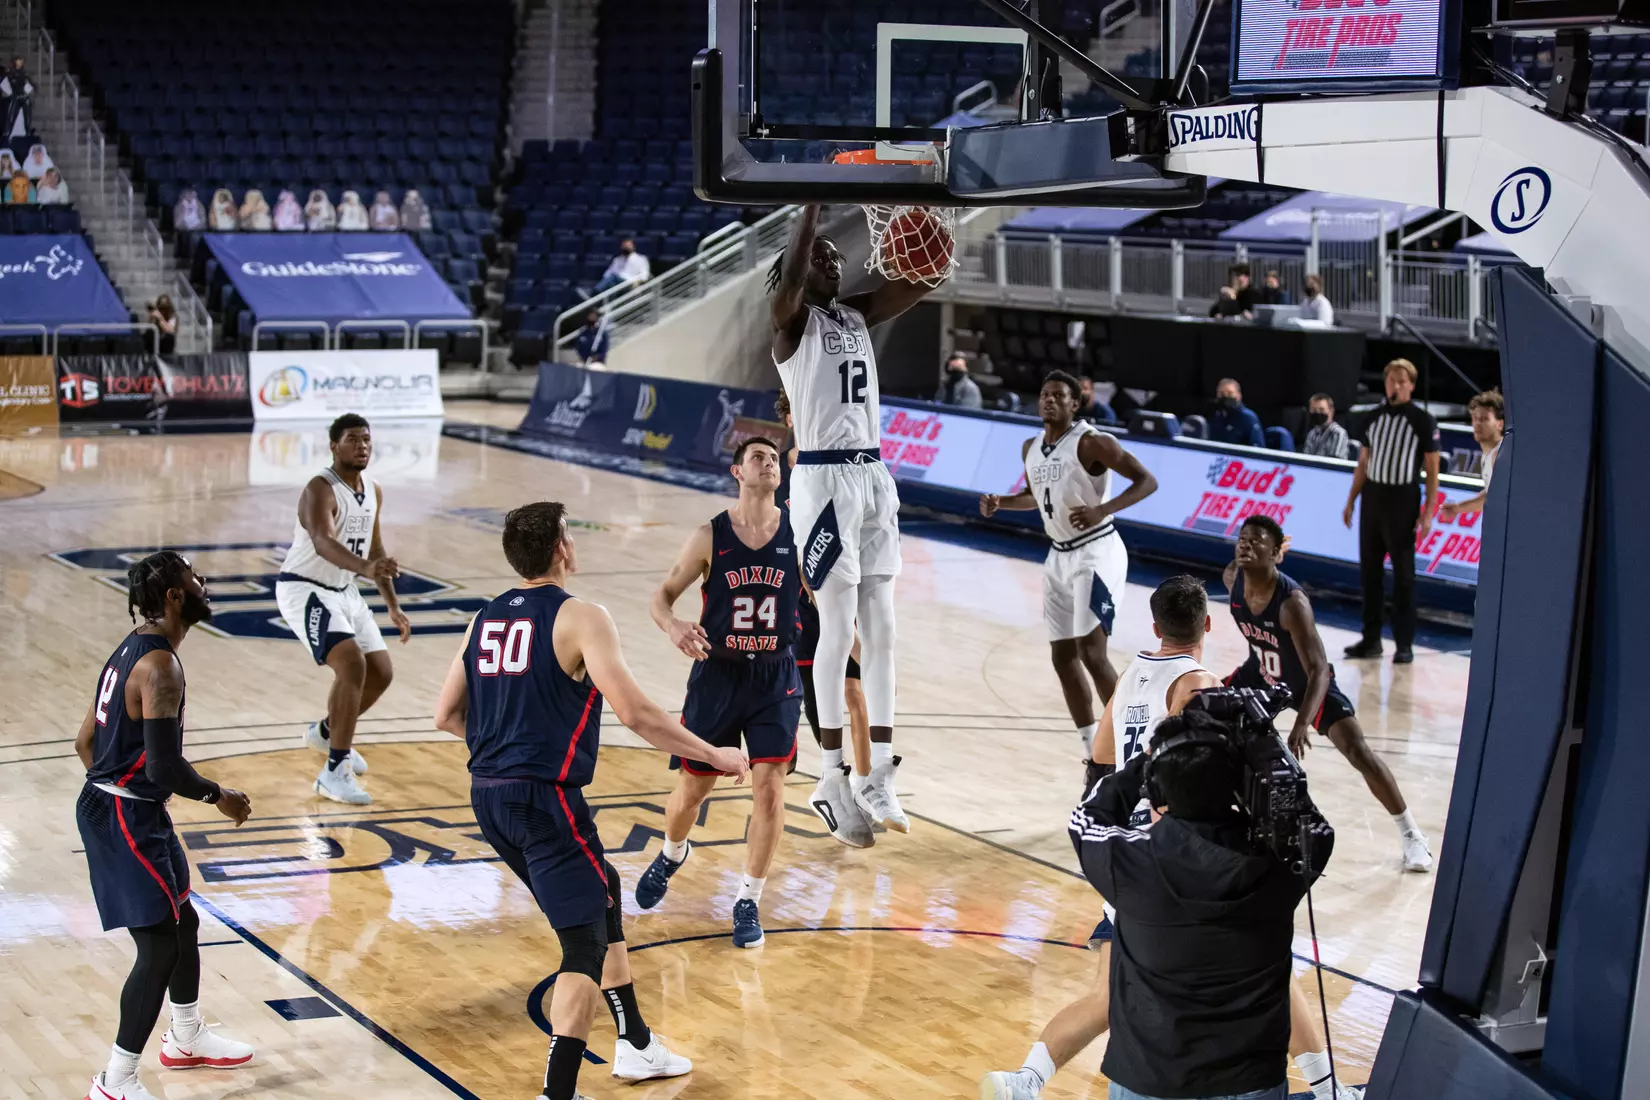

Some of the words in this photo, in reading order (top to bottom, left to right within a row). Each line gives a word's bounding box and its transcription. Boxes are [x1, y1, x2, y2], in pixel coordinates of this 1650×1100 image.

[1276, 18, 1334, 70] TIRE
[1327, 13, 1403, 68] PROS
[1170, 105, 1258, 149] SPALDING
[838, 360, 868, 404] 12
[1032, 464, 1061, 485] CBU
[1217, 461, 1294, 497] Bud's
[1043, 487, 1054, 520] 4
[1184, 491, 1240, 530] TIRE
[1225, 499, 1292, 536] PROS
[805, 527, 835, 579] LANCERS
[725, 565, 785, 590] DIXIE
[310, 606, 323, 646] LANCERS
[732, 595, 777, 630] 24
[477, 617, 535, 677] 50
[726, 634, 778, 651] STATE
